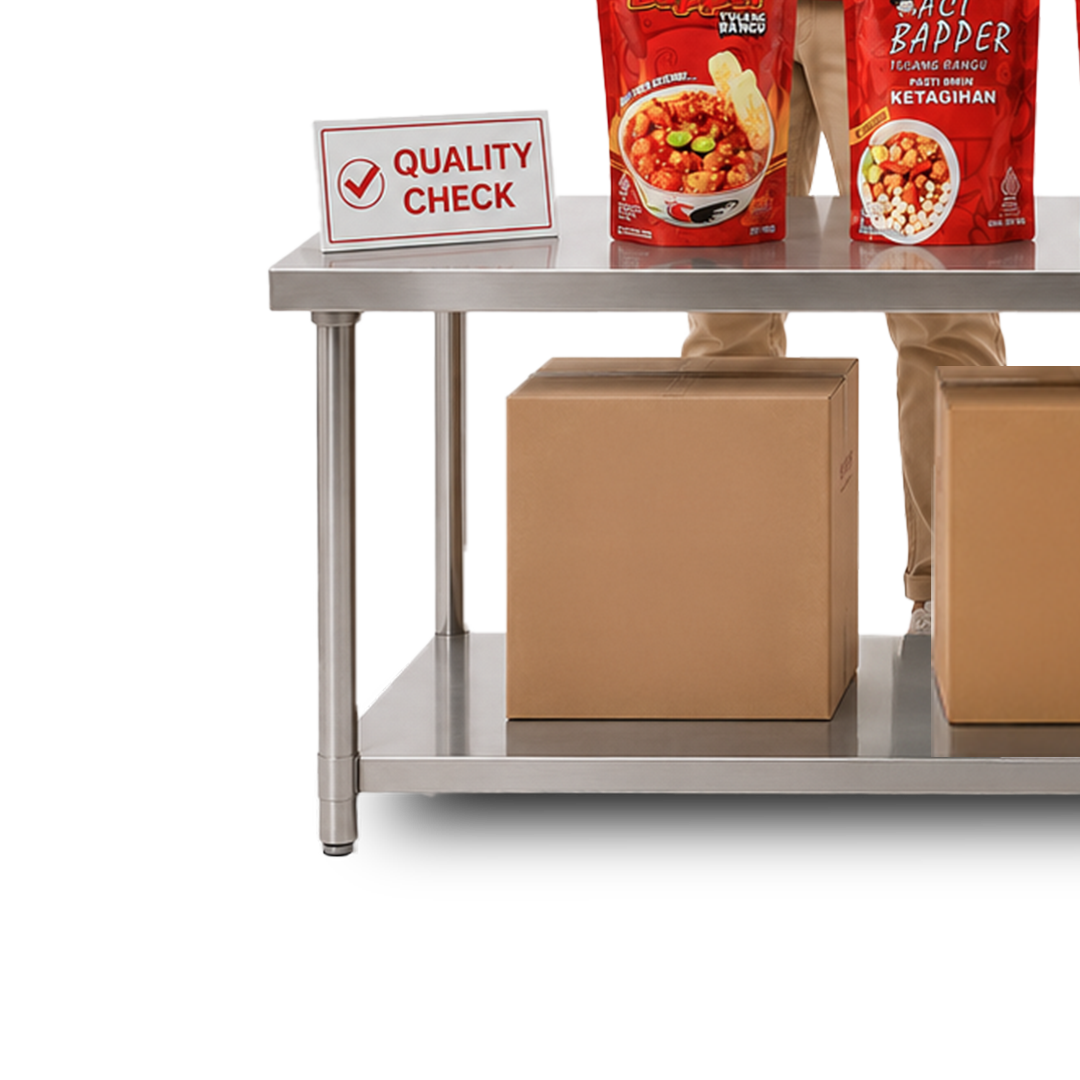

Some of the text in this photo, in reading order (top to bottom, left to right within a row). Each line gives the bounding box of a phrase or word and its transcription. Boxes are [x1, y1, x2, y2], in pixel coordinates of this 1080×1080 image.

[889, 19, 1011, 55] BAPPER
[890, 89, 997, 105] KETAGIHAN
[393, 141, 533, 179] QUALITY
[403, 181, 517, 216] CHECK
